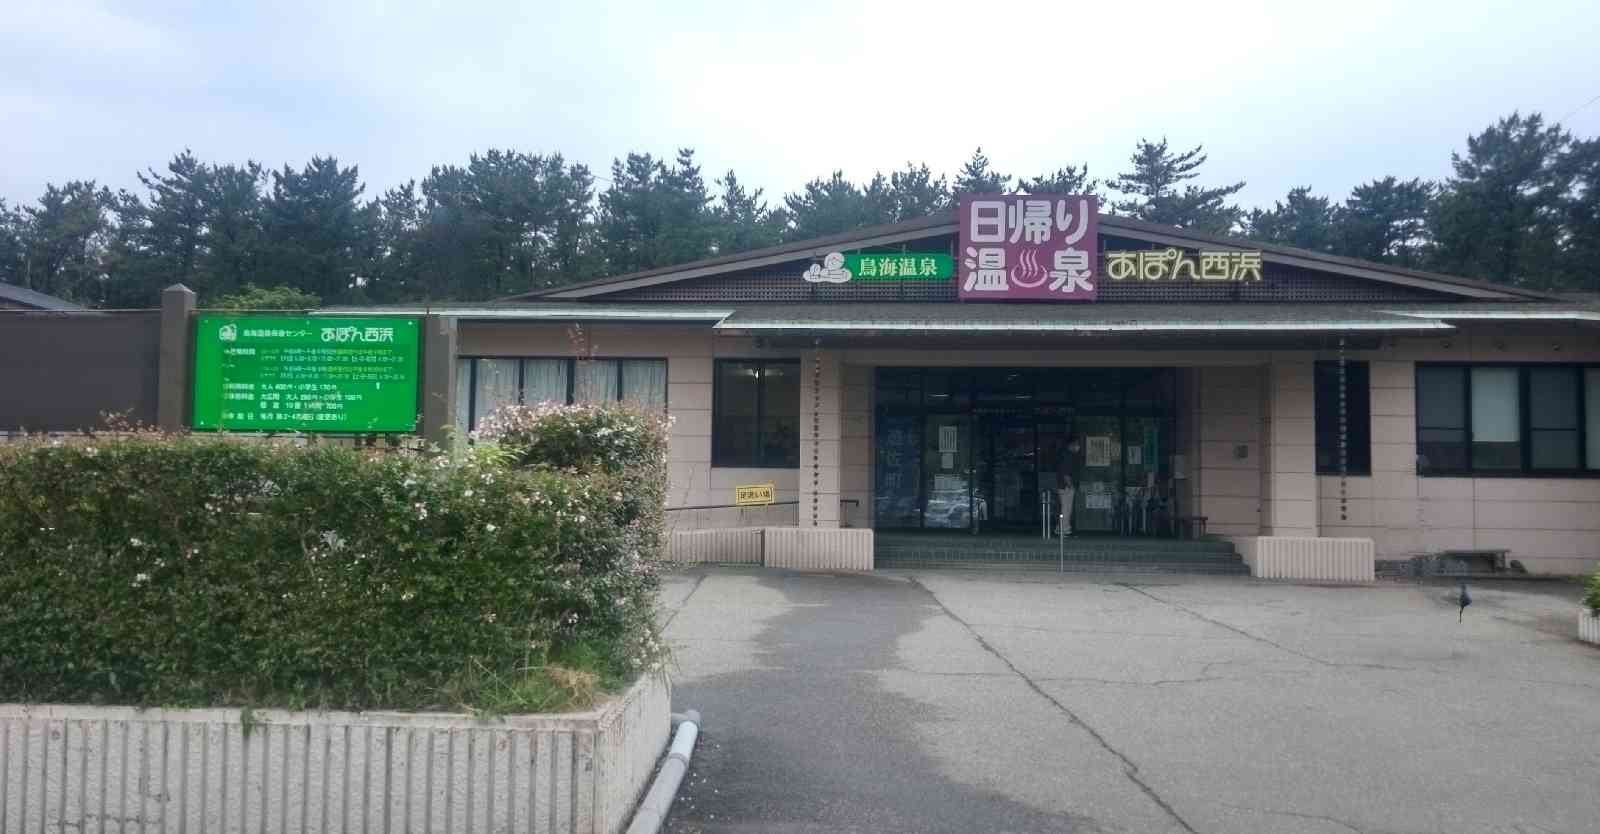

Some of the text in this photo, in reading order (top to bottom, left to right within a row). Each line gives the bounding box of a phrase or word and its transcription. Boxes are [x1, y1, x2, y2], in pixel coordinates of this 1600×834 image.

[970, 199, 1088, 244] 日帰り
[858, 257, 938, 277] 鳥海温泉
[1107, 248, 1262, 281] あぽん西浜
